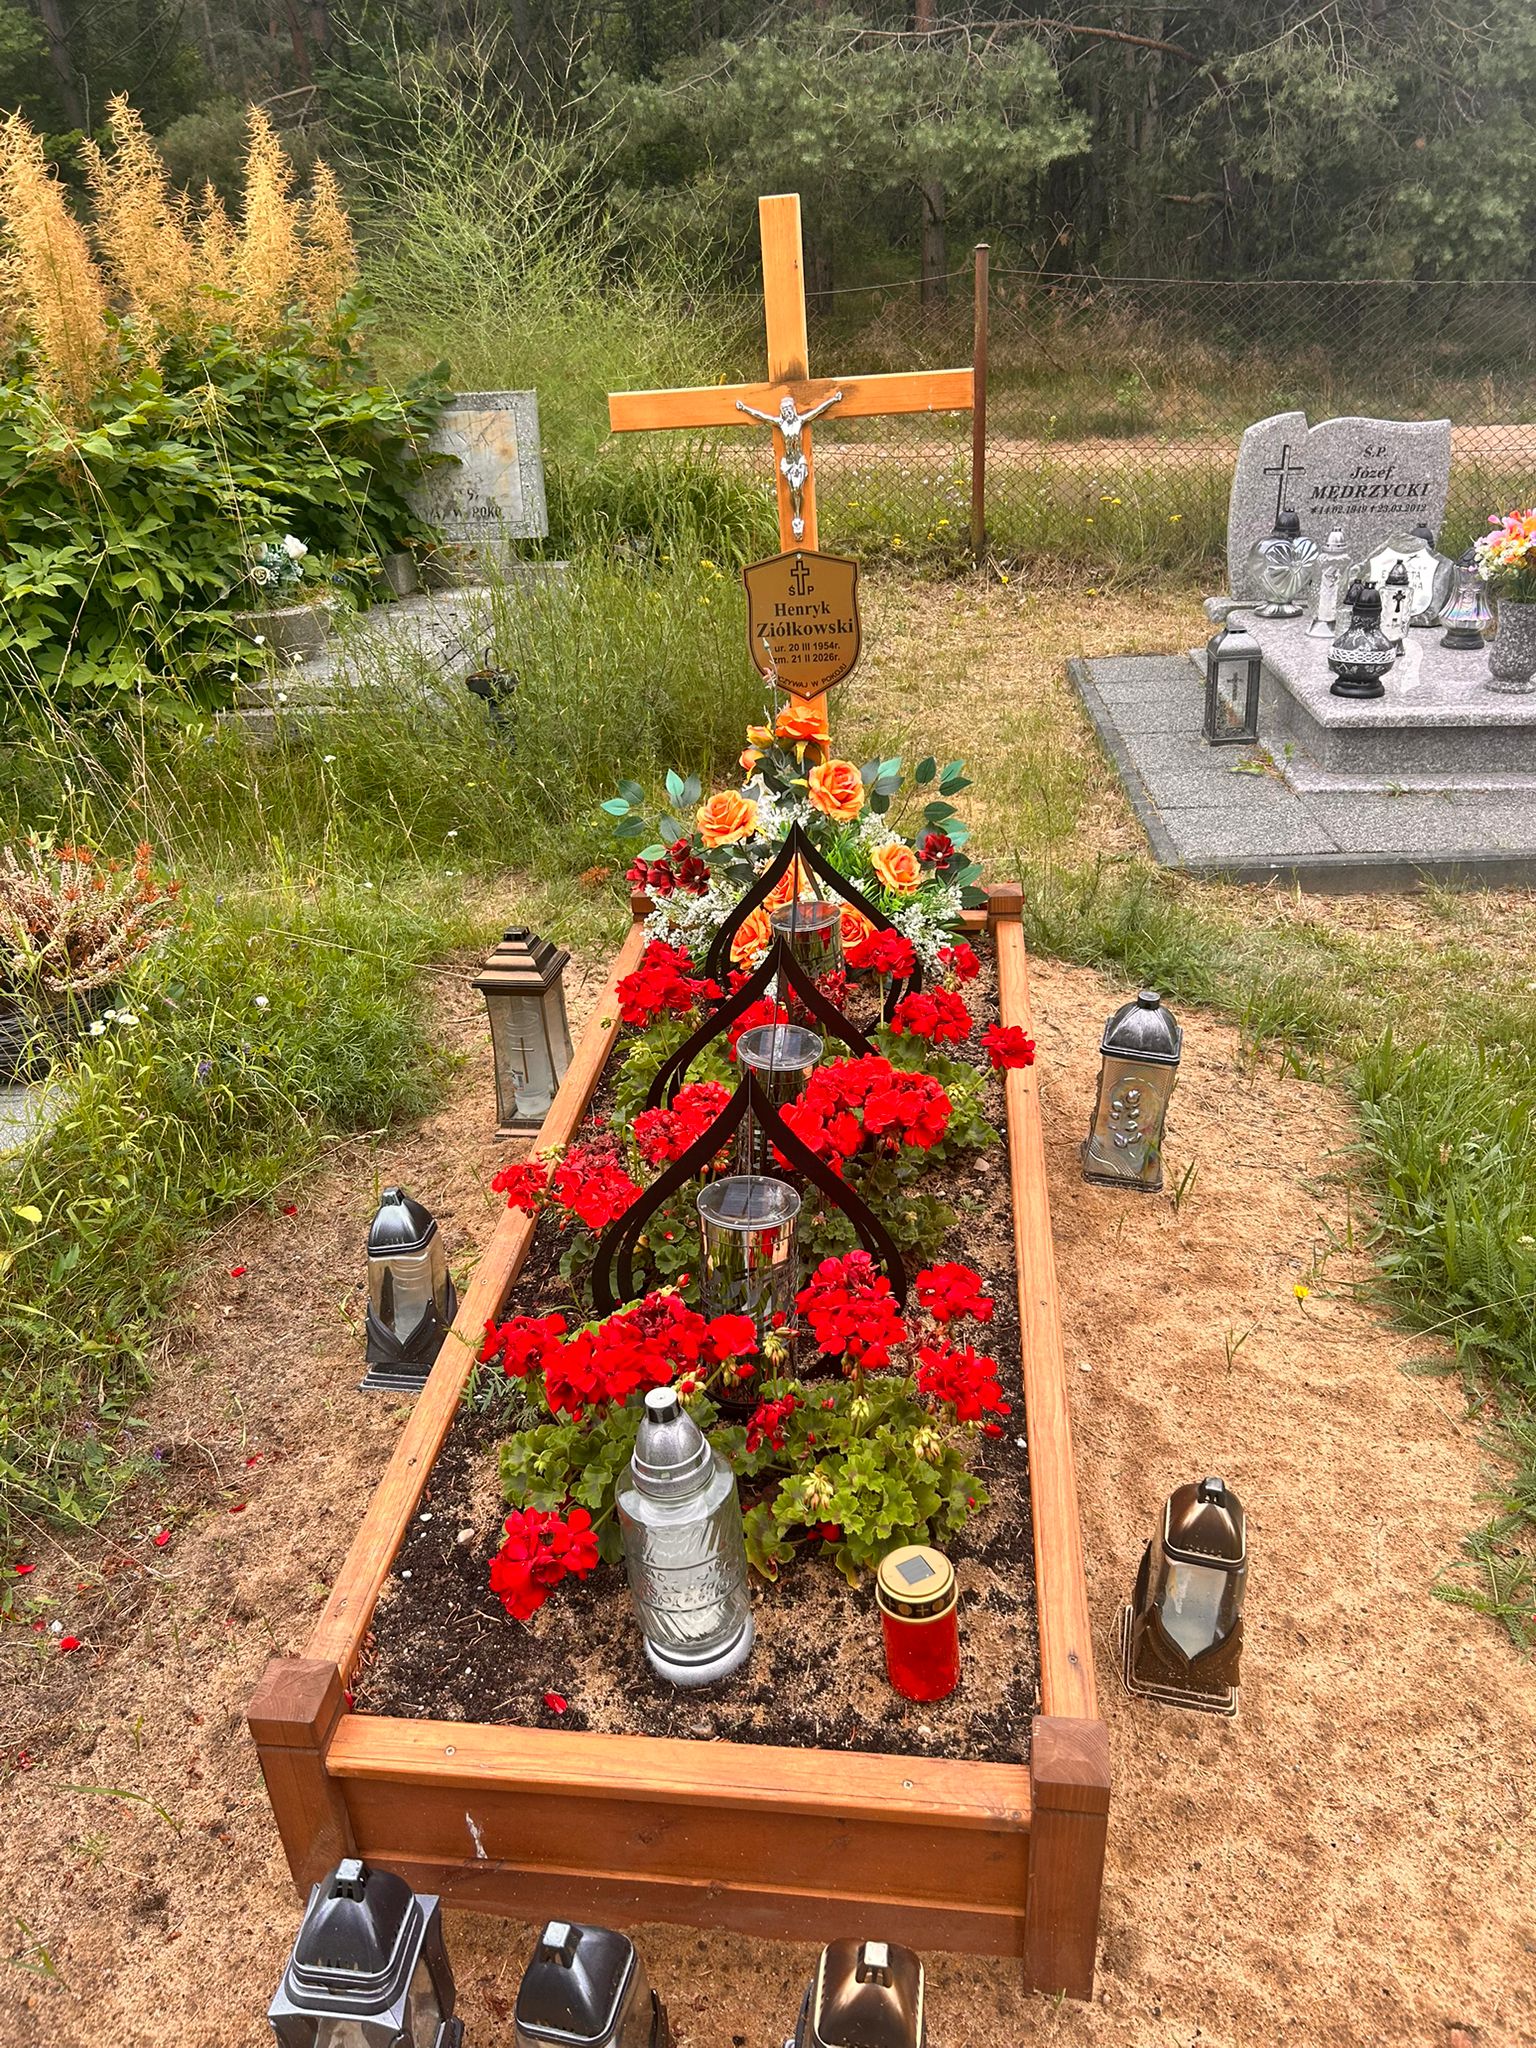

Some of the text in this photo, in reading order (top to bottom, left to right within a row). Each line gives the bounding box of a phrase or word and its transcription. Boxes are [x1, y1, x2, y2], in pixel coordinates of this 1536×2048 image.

[1350, 465, 1396, 480] Józef
[1311, 483, 1430, 502] MĘDRZYCKI
[788, 585, 814, 596] Ś P
[775, 601, 831, 619] Henryk
[756, 618, 854, 638] Ziółkowski
[774, 641, 841, 653] ur. 20 III 1954r.
[773, 652, 841, 665] zm. 21 II 2026r.
[821, 663, 847, 684] POKOJU
